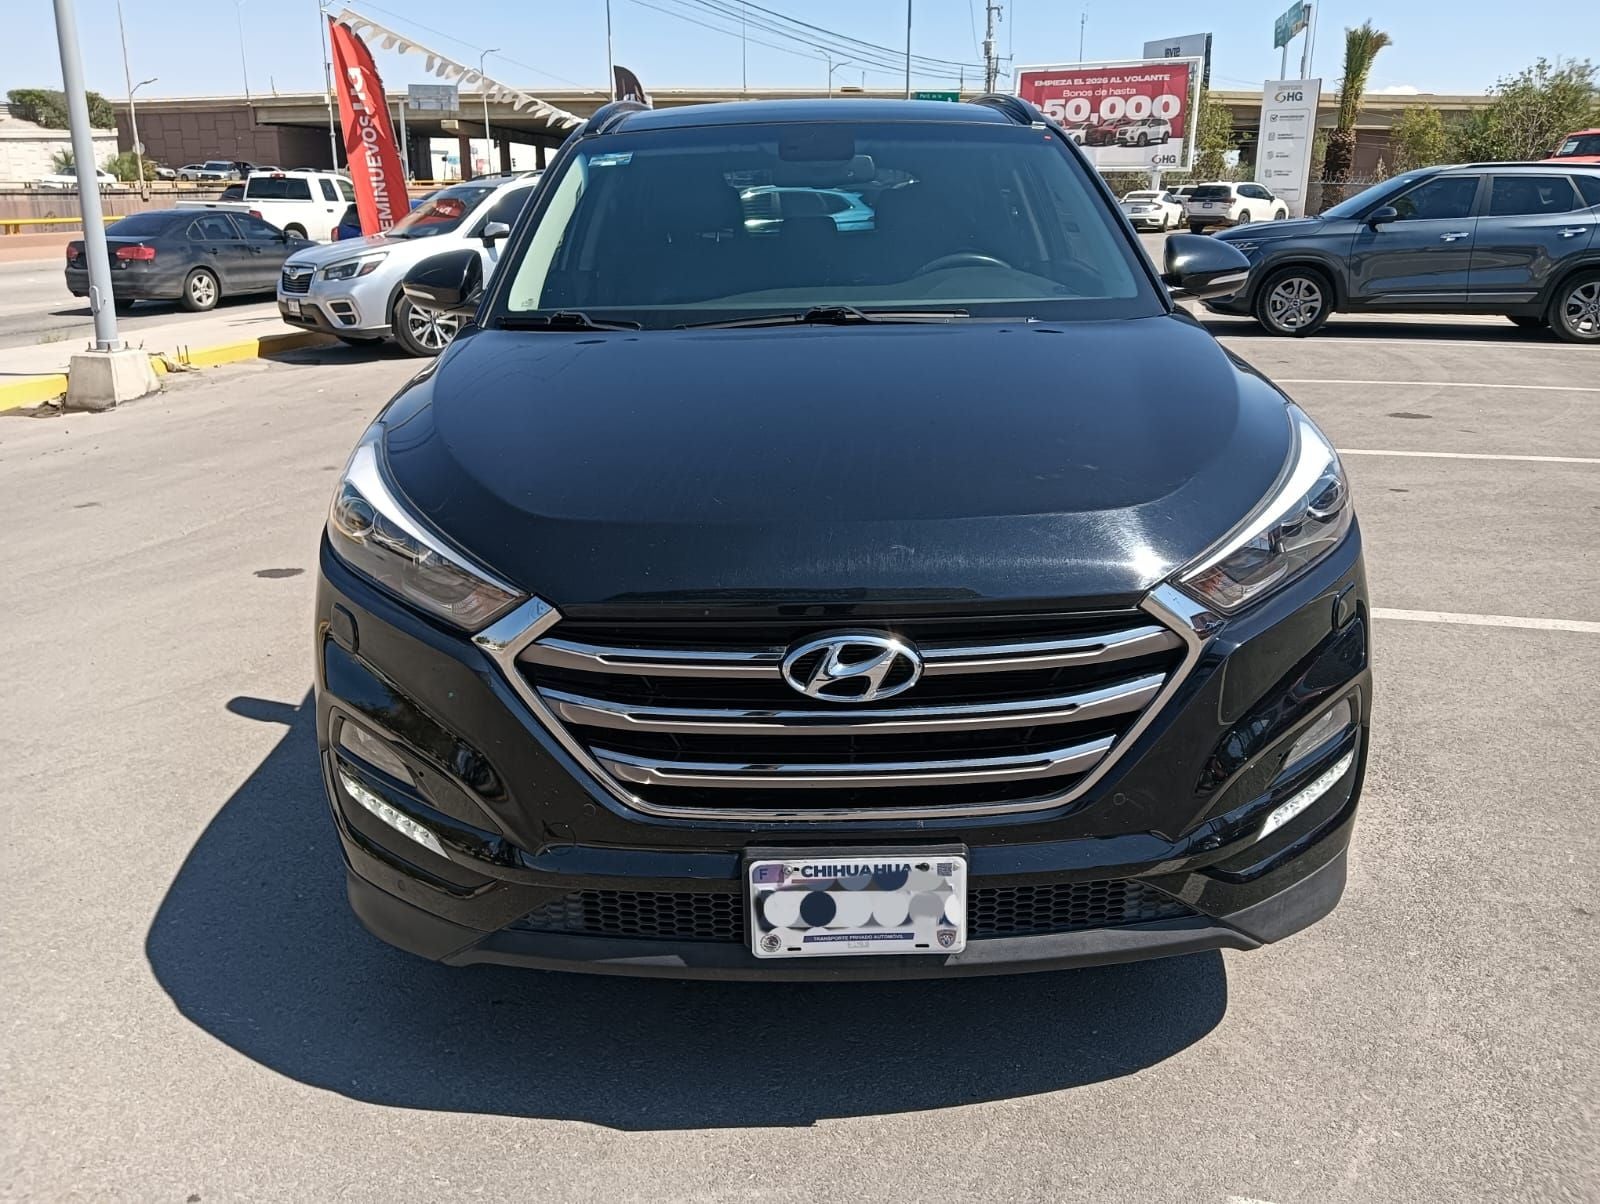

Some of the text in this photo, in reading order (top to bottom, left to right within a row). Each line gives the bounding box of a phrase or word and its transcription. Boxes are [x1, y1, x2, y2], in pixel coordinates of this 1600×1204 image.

[1034, 79, 1072, 87] EMPIEZA
[1073, 78, 1085, 86] EL
[1124, 74, 1170, 82] VOLANTE
[1063, 87, 1137, 97] Bonos de hasta
[1286, 91, 1303, 102] HG
[359, 115, 394, 238] EMINUEVOS
[759, 864, 912, 880] F CHIHUAHUA
